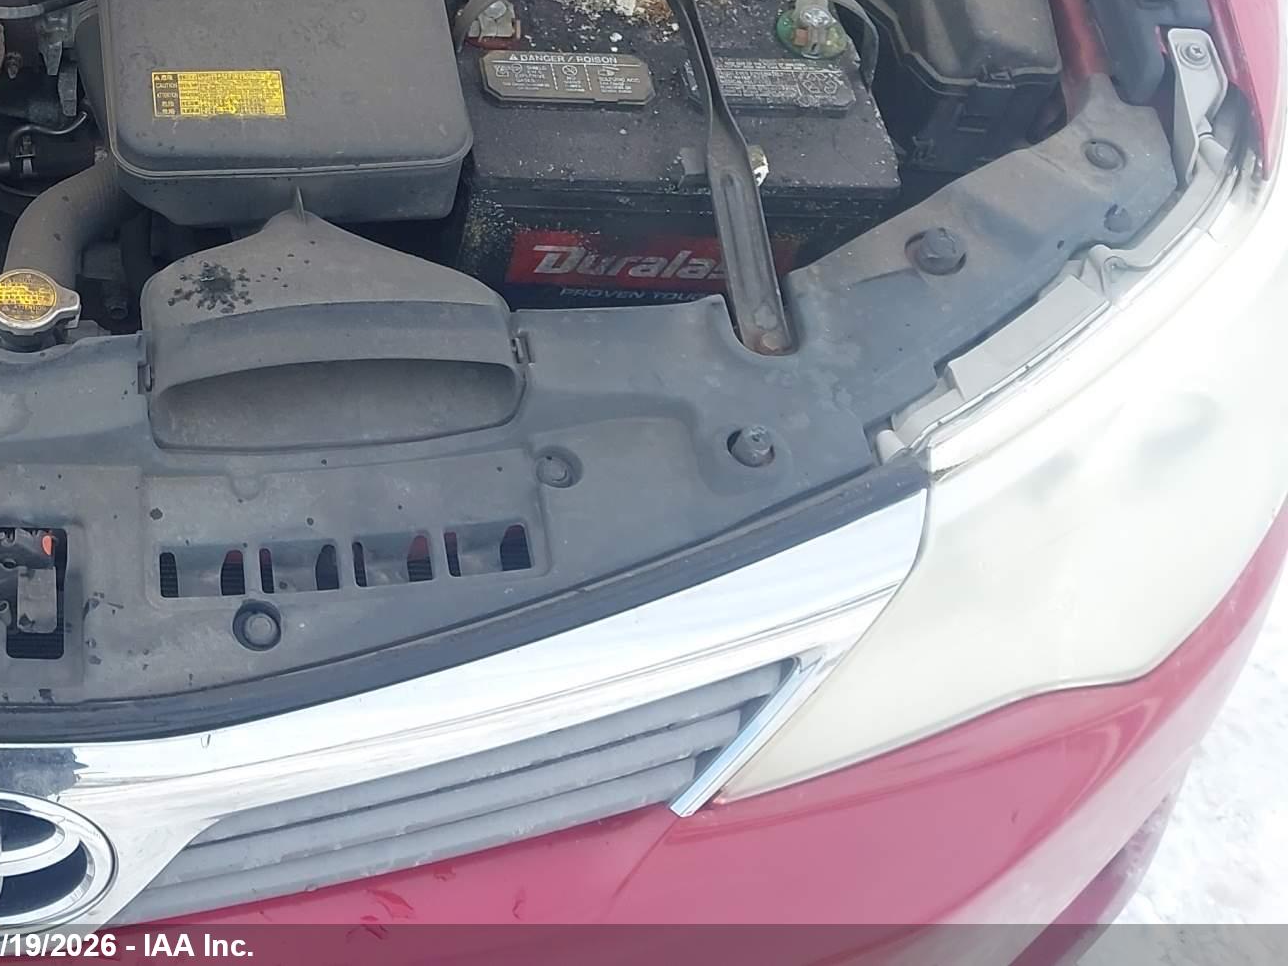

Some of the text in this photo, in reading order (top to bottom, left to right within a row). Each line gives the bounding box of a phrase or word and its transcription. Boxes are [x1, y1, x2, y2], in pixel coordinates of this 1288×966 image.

[519, 54, 566, 63] DANGER
[576, 55, 618, 64] POISON
[560, 288, 646, 299] PROVEN
